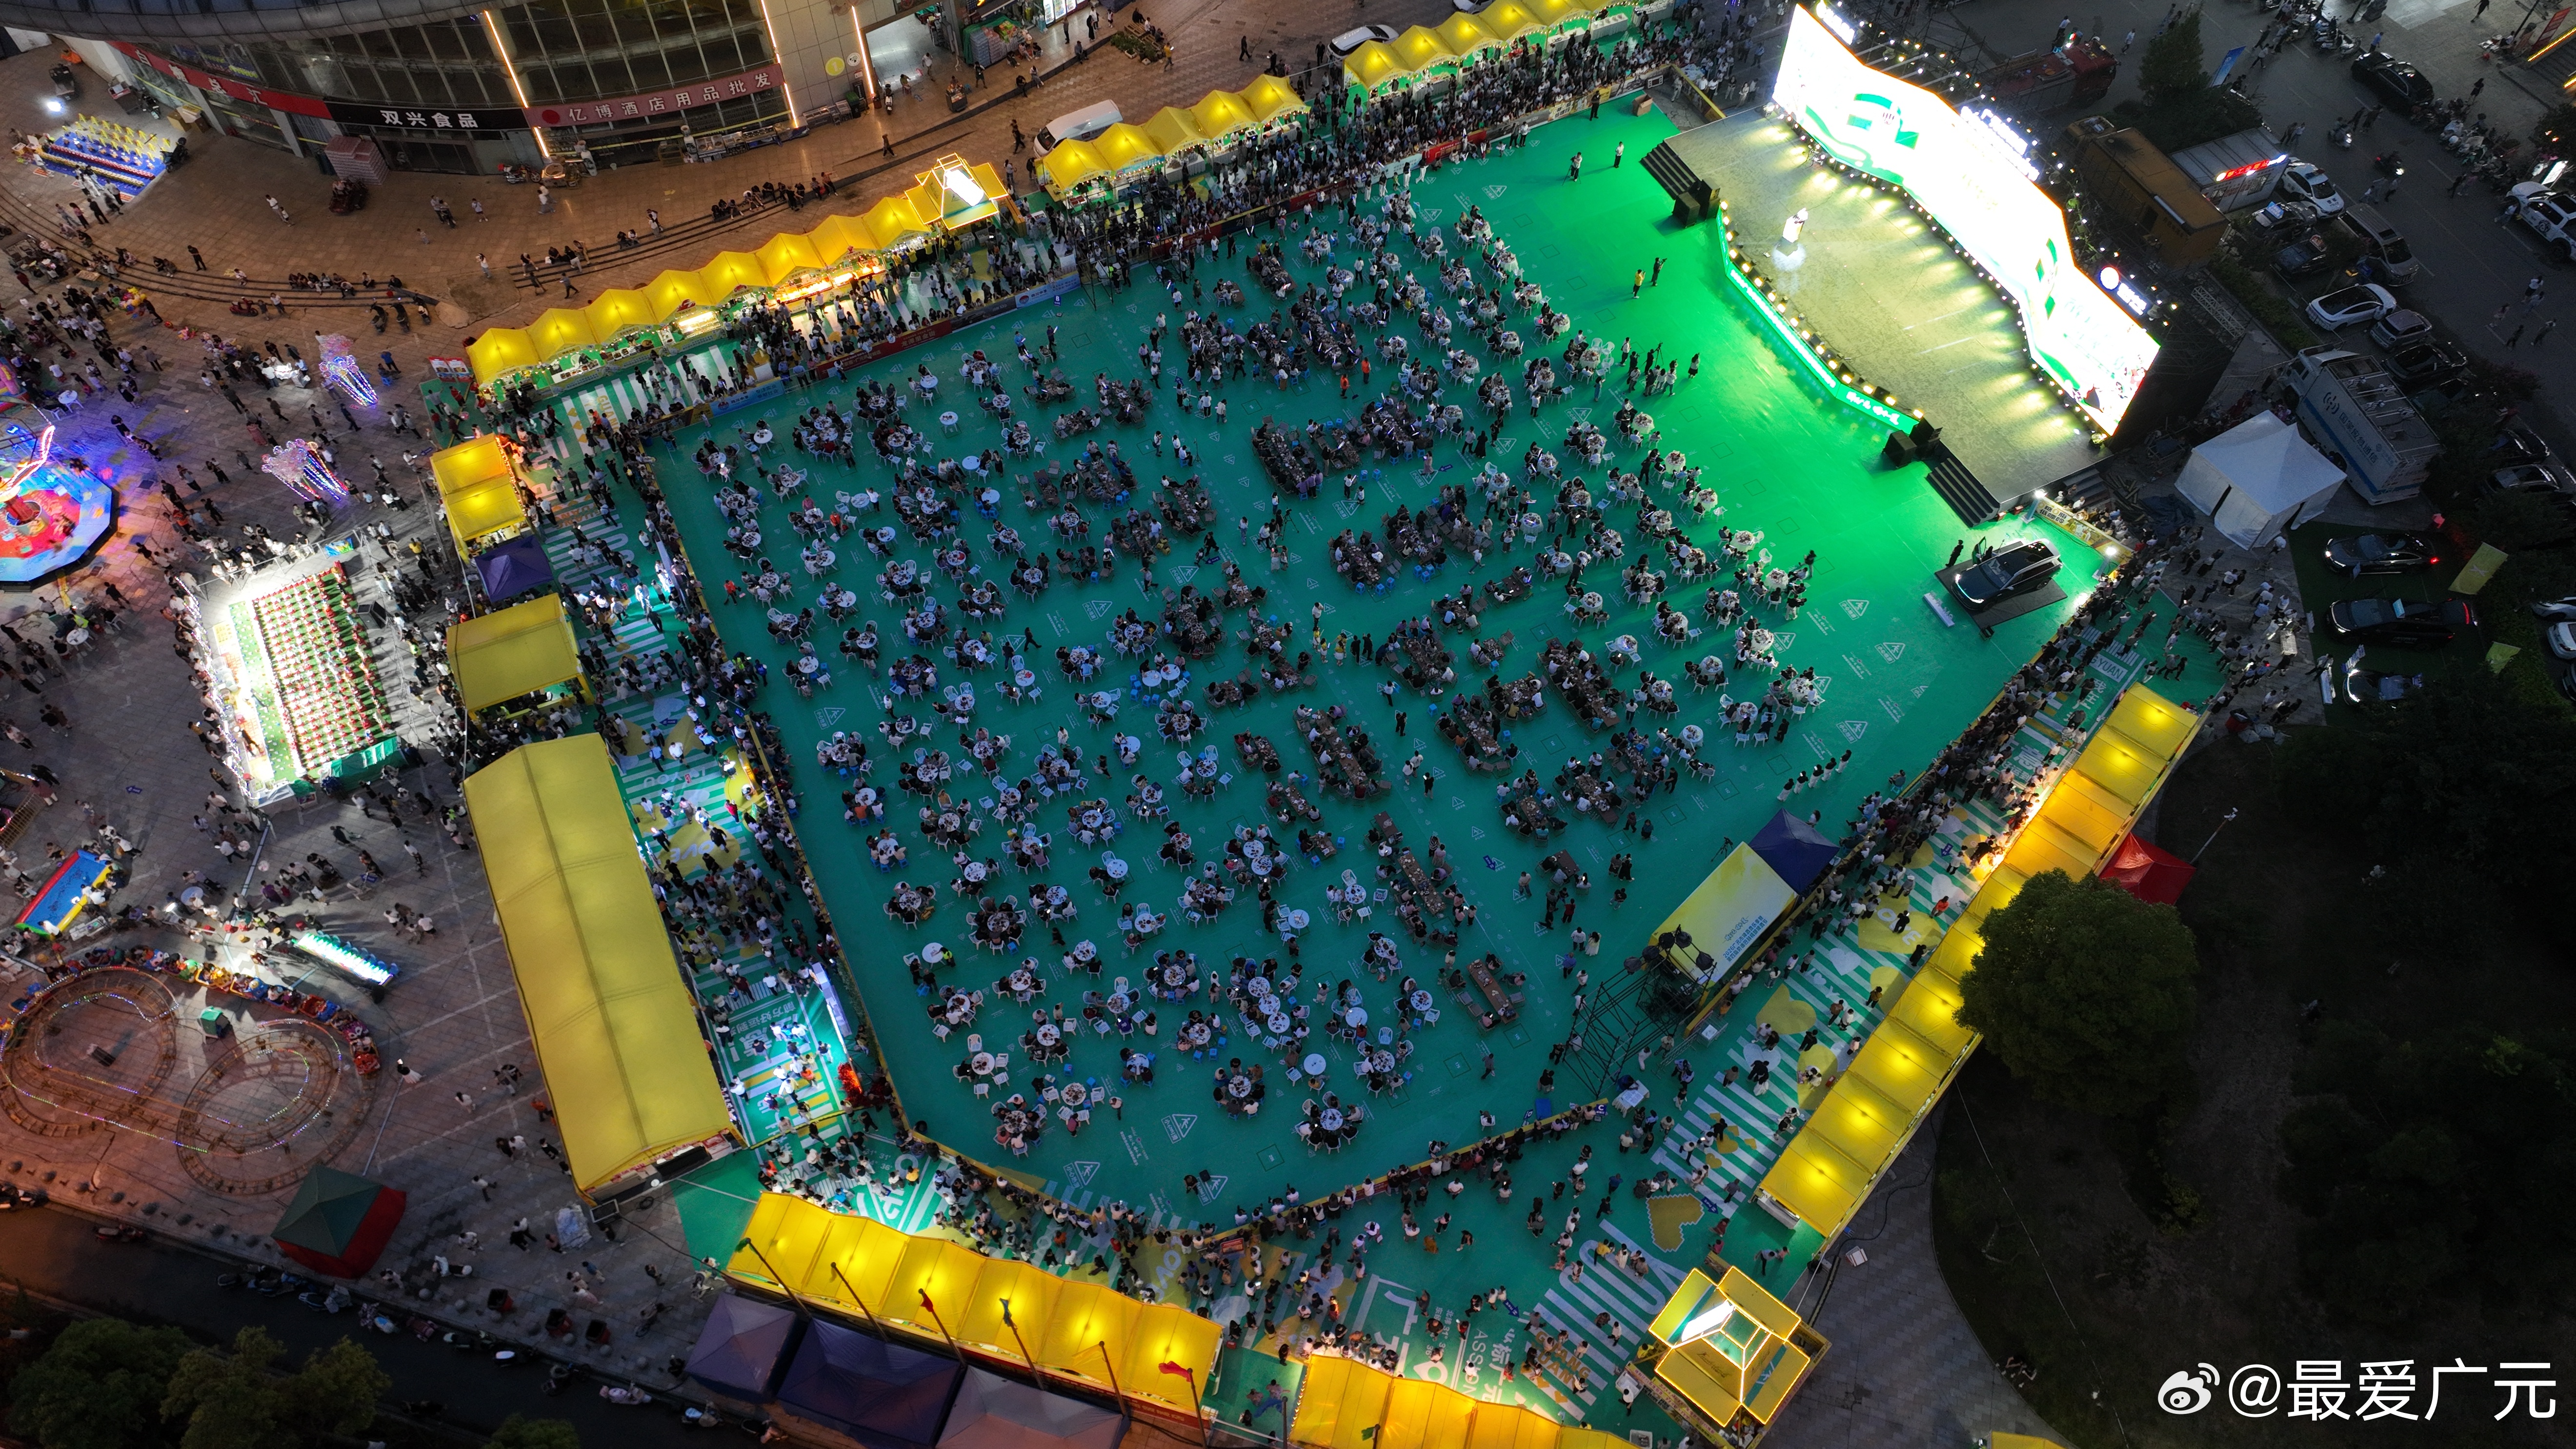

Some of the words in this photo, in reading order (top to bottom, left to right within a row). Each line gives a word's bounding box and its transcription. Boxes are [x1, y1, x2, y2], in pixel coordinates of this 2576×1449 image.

[569, 73, 771, 121] 亿博酒店用品批发
[380, 110, 478, 128] 双兴食品
[2337, 412, 2379, 463] 国家应急通信
[2098, 659, 2123, 679] YUAN
